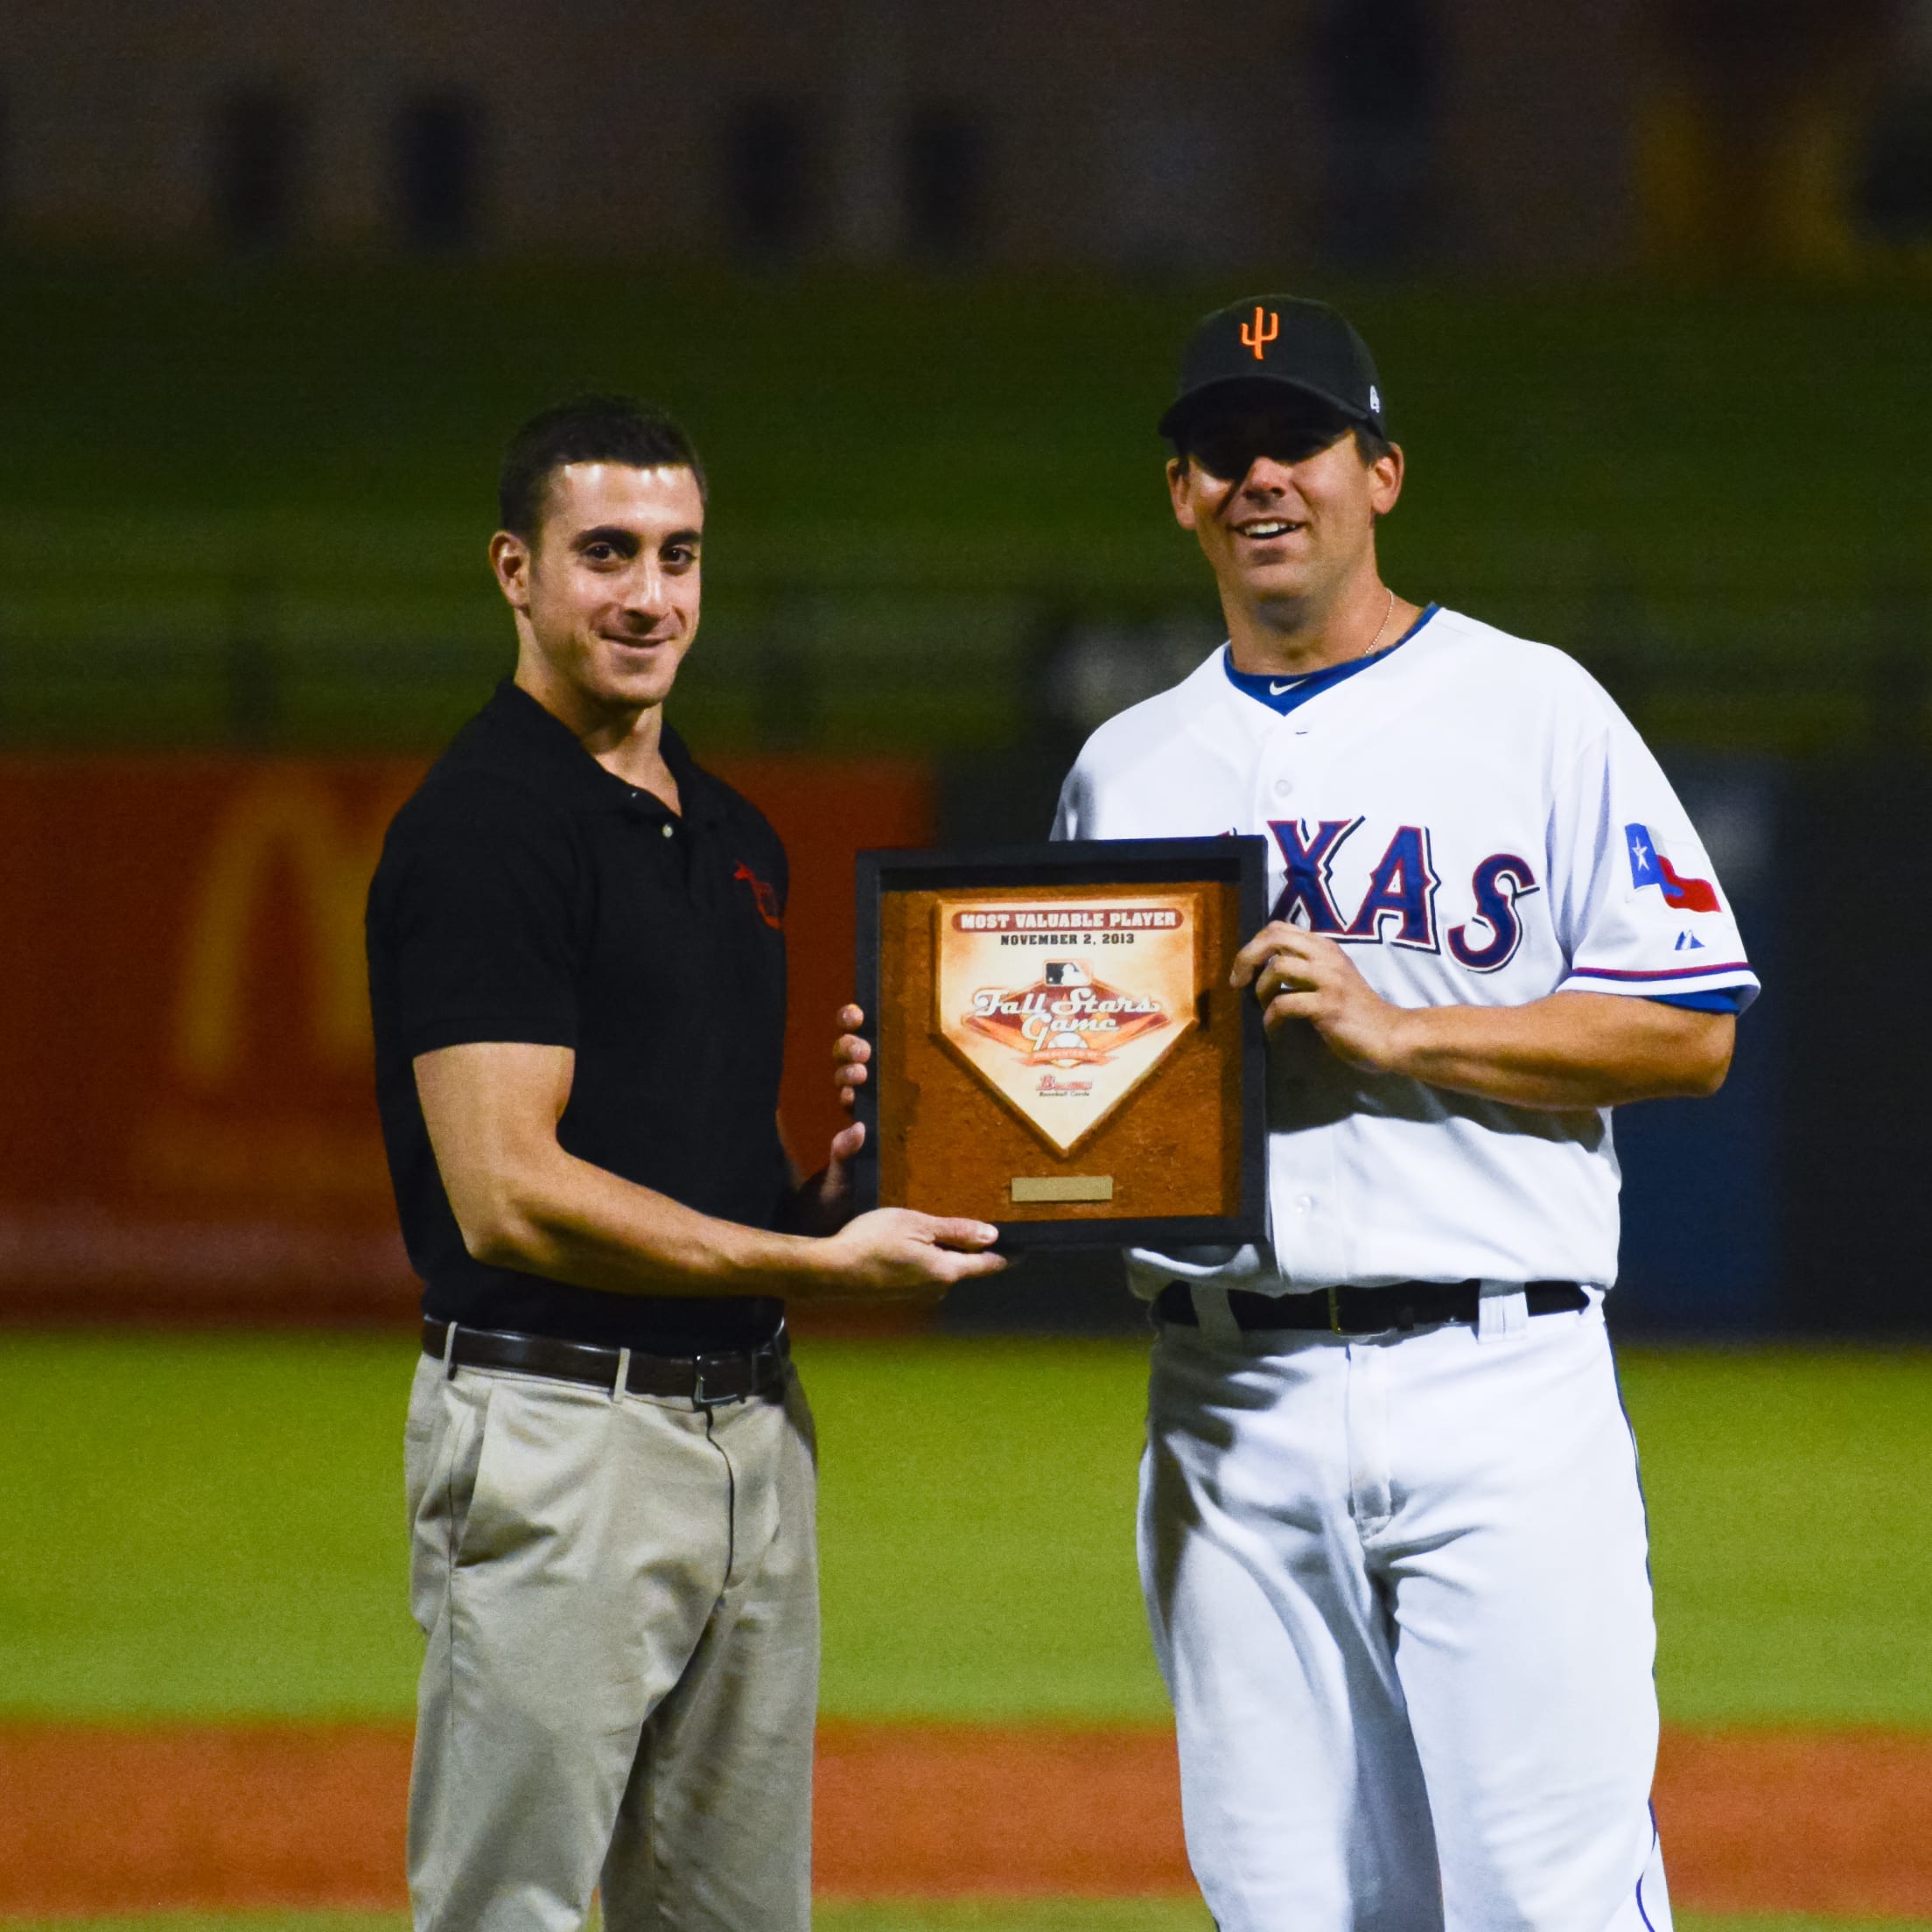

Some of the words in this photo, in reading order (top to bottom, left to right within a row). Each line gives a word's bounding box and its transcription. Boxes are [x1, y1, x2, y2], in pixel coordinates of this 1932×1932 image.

[1266, 815, 1540, 974] XAS
[960, 913, 1010, 929] MOST
[1015, 912, 1104, 928] VALUABLE
[1110, 911, 1177, 928] PLAYER
[1000, 934, 1078, 947] NOVEMBER
[1083, 934, 1096, 946] 2,
[1102, 933, 1135, 945] 2013
[973, 988, 1048, 1017] Fall
[1051, 987, 1161, 1015] Stars
[1021, 1012, 1120, 1051] Game
